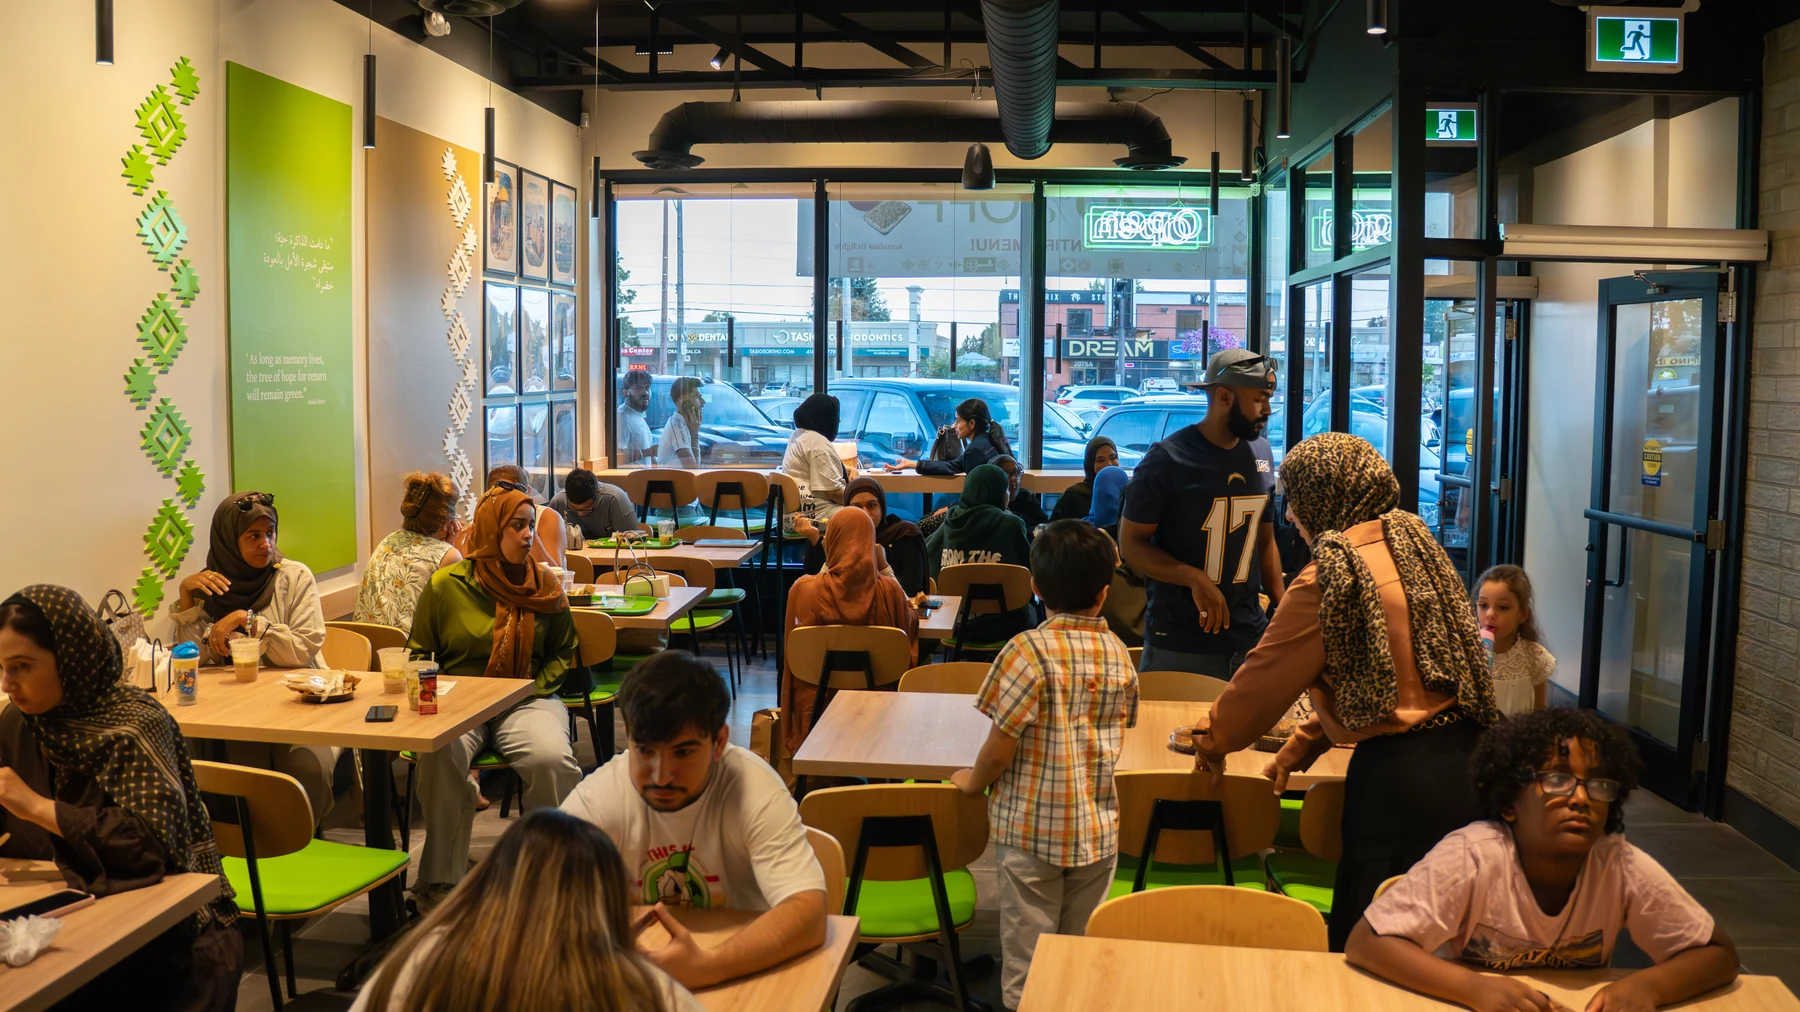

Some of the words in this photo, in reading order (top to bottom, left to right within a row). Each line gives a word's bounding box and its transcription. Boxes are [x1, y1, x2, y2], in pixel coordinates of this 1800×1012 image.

[790, 332, 815, 342] TASI
[1069, 340, 1154, 357] DREAM
[259, 351, 274, 368] long
[275, 355, 282, 364] as
[283, 355, 308, 368] memory
[309, 352, 324, 366] lives,
[246, 370, 258, 382] the
[259, 372, 273, 382] tree
[274, 369, 281, 382] of
[281, 369, 297, 385] hope
[298, 369, 307, 381] for
[308, 372, 327, 381] return
[246, 388, 259, 401] will
[261, 388, 284, 400] remain
[1201, 494, 1269, 585] 17
[968, 549, 1002, 564] THE
